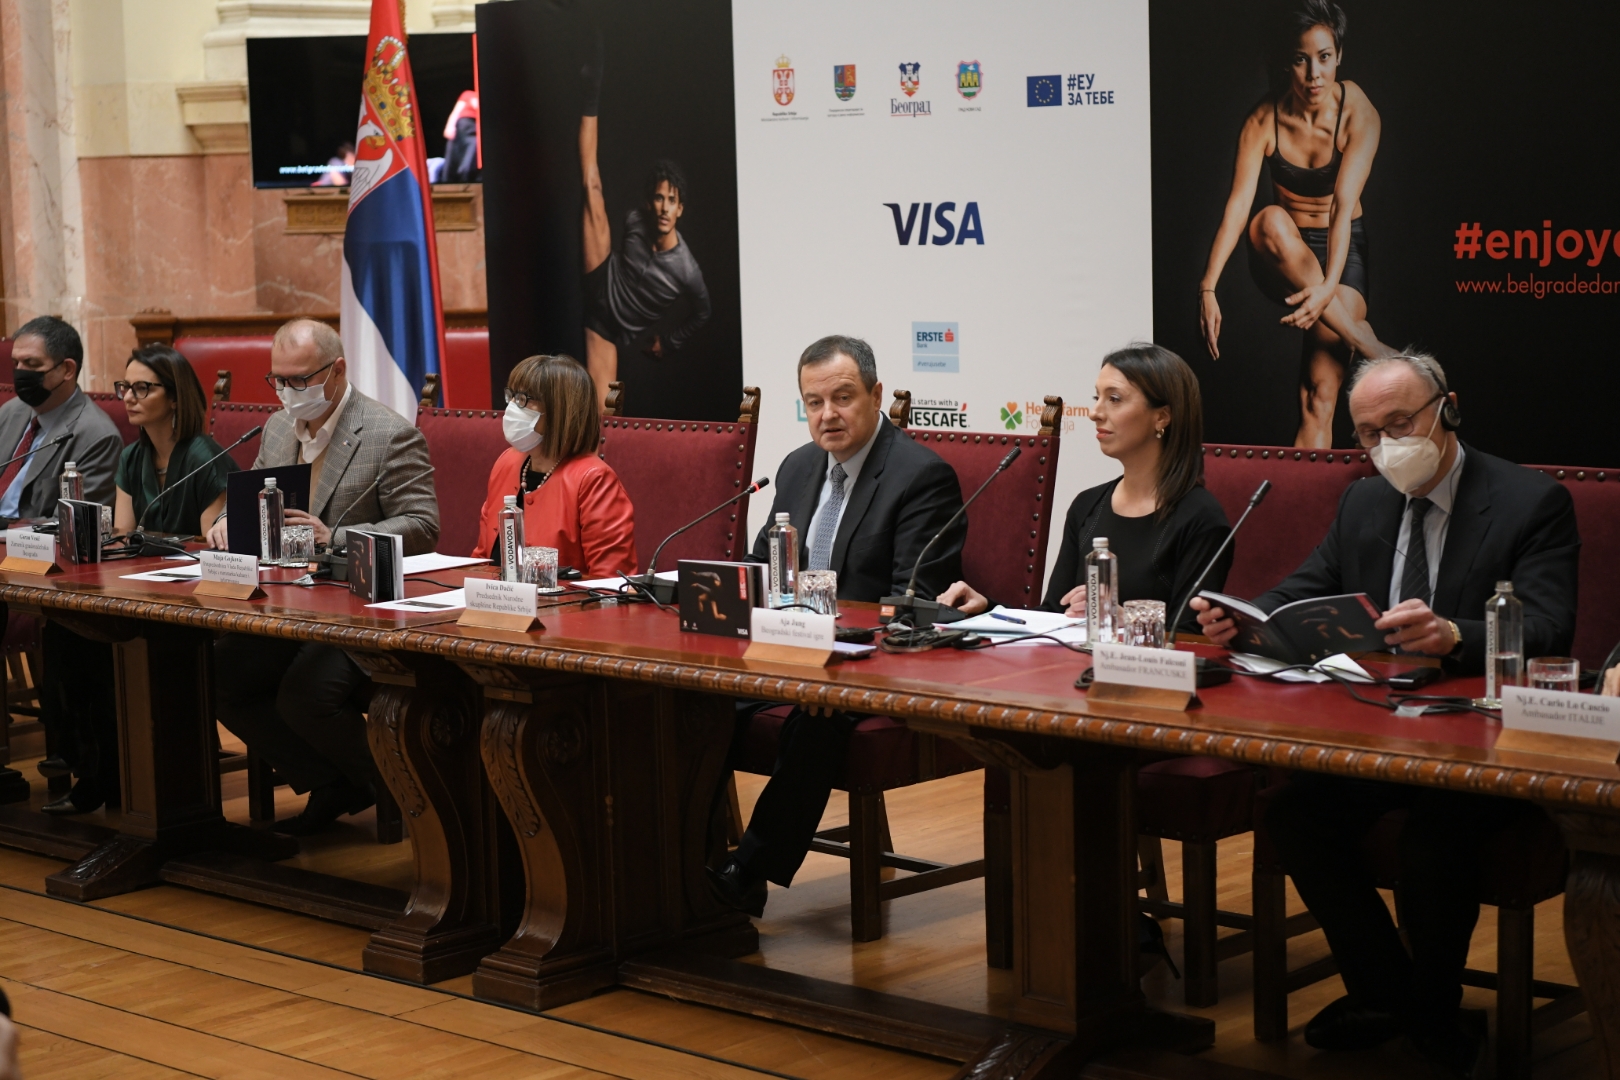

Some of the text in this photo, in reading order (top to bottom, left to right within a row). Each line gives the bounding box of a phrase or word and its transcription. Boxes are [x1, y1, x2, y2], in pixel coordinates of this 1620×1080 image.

[1067, 73, 1095, 91] #ЕУ
[1068, 90, 1114, 106] ЗА ТЕБЕ
[890, 98, 931, 118] Београд
[882, 202, 985, 246] VISA
[916, 331, 944, 342] ERSTE
[917, 398, 937, 406] starts
[938, 398, 952, 407] with
[486, 583, 498, 591] Ivica
[476, 591, 524, 603] Predsednik Narodne
[492, 602, 516, 612] Republike
[517, 605, 532, 614] Srbije
[1120, 652, 1159, 664] Jean-Louis
[1101, 662, 1187, 679] Ambasador FRANCUSKE
[1540, 697, 1565, 708] Carlo
[1566, 700, 1579, 710] Lo
[1580, 702, 1610, 713] Cascio
[1521, 708, 1567, 721] Ambasador
